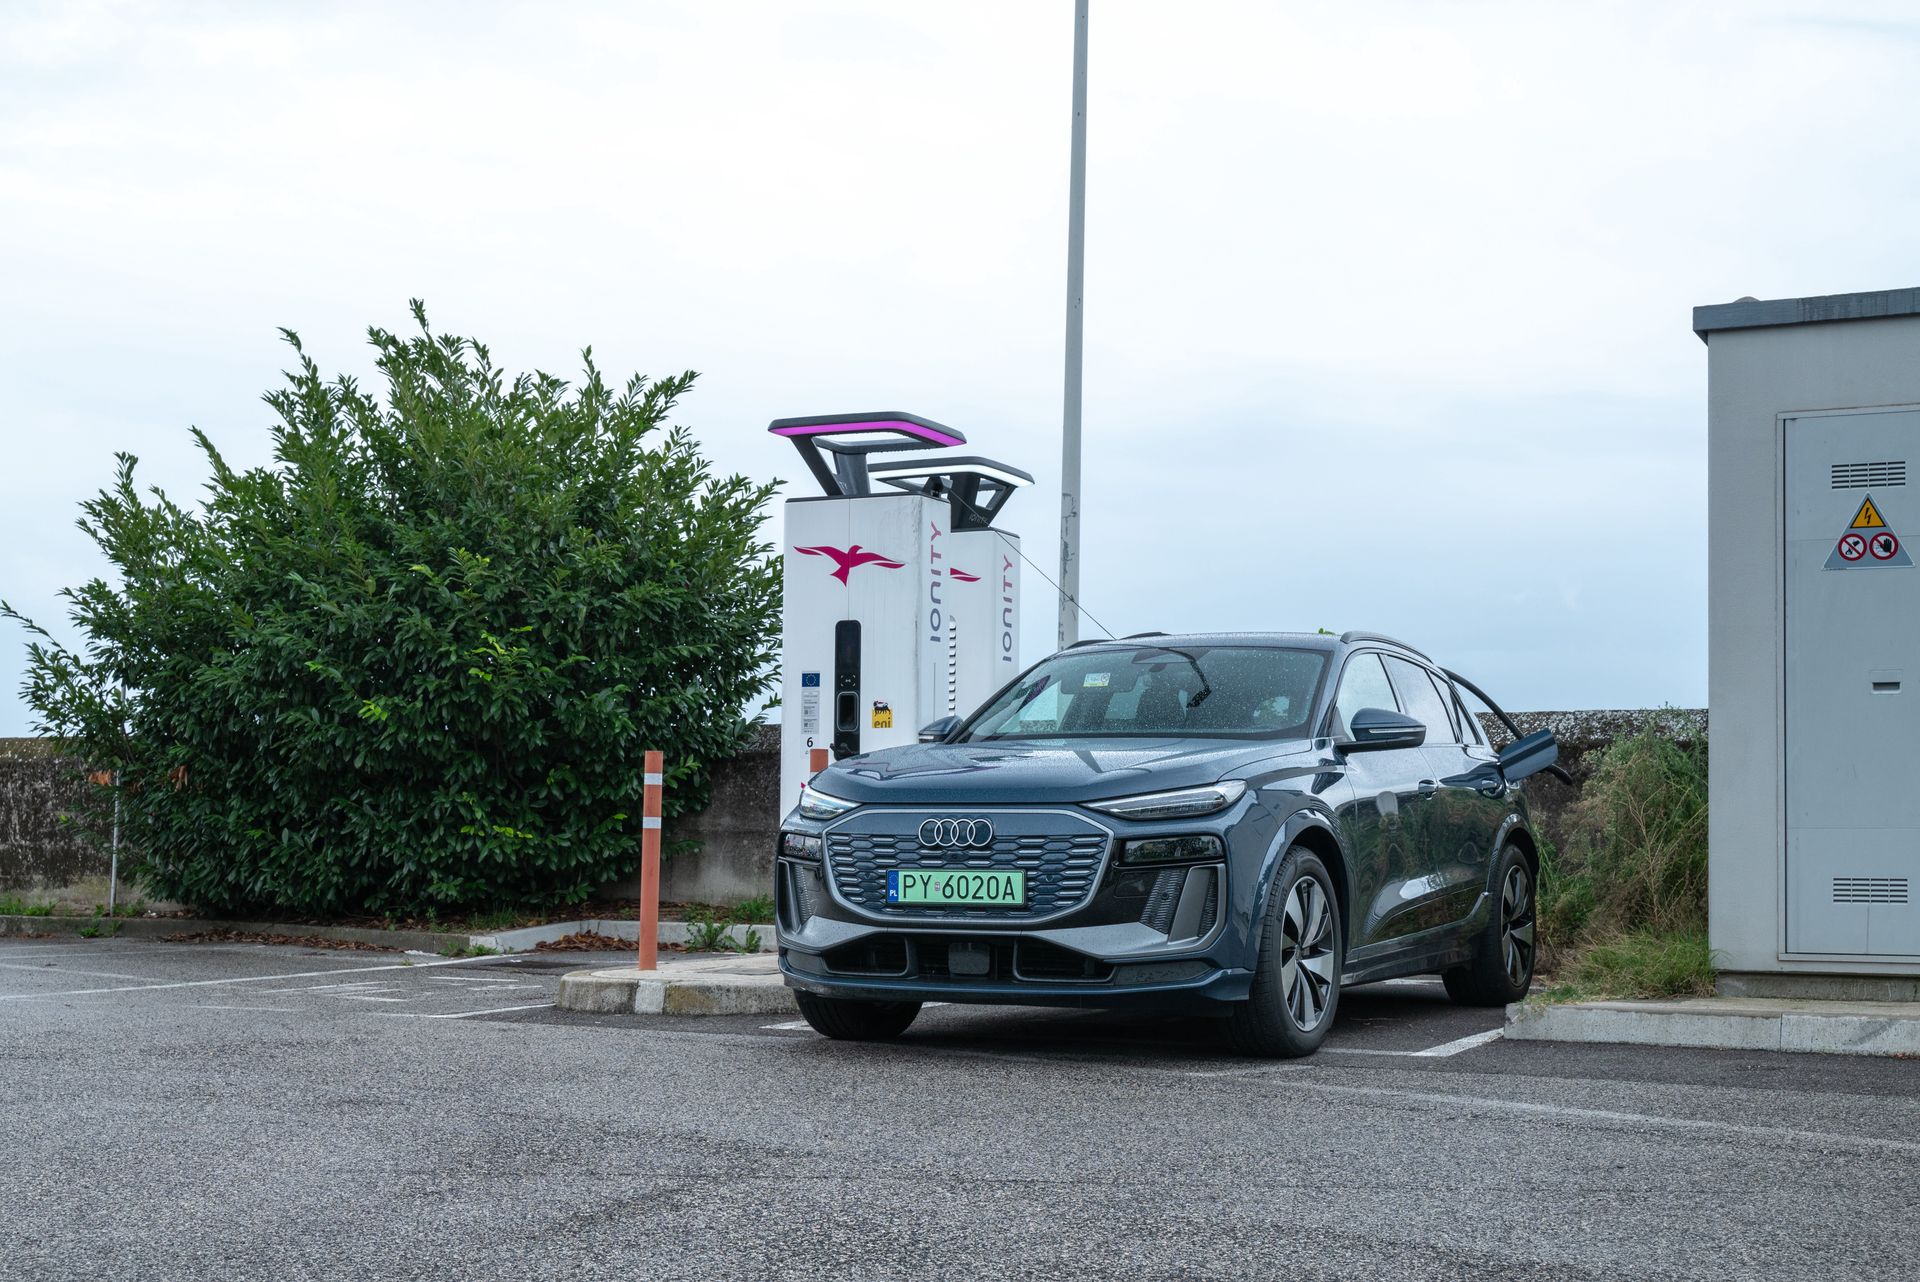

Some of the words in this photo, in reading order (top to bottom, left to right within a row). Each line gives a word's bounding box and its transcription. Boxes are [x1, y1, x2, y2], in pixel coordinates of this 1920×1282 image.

[874, 717, 891, 728] eni
[806, 736, 814, 748] 6
[889, 889, 898, 897] PL
[903, 874, 932, 899] PY
[942, 874, 1016, 901] 6020A
